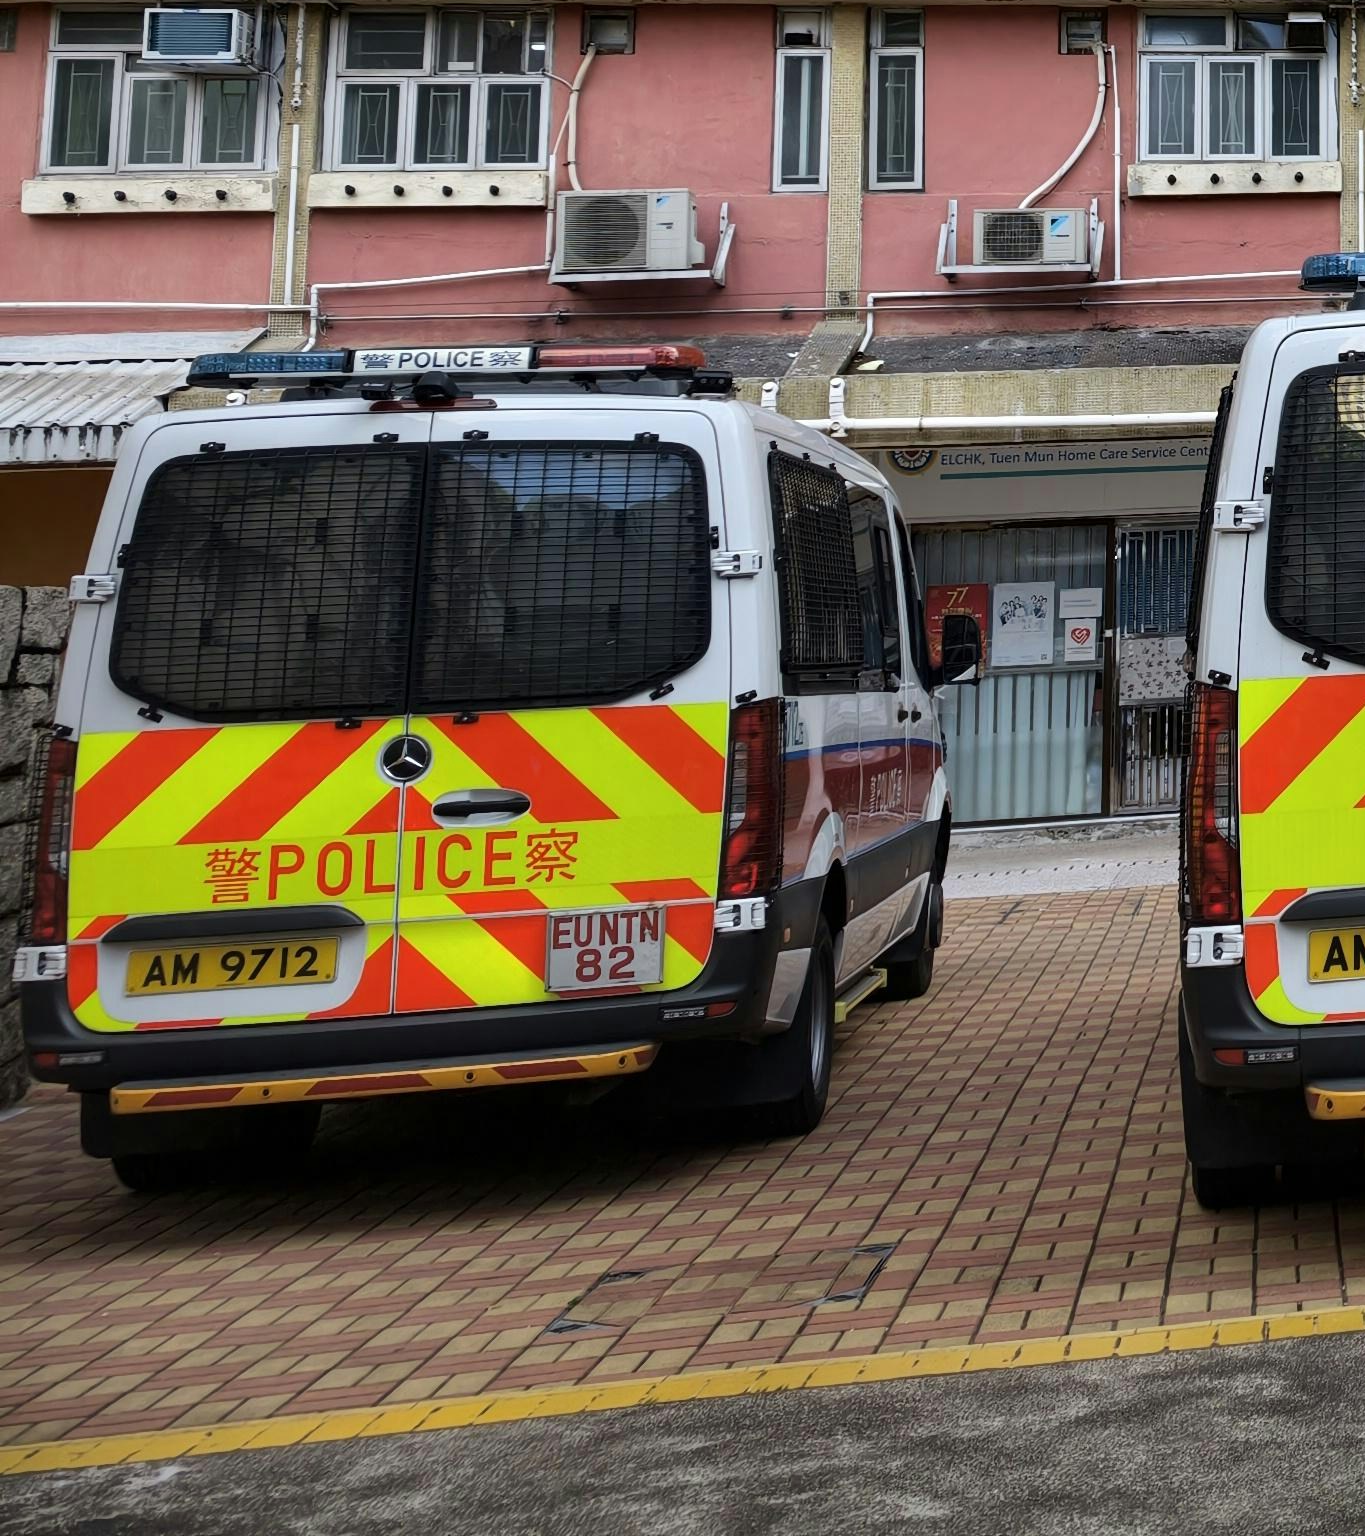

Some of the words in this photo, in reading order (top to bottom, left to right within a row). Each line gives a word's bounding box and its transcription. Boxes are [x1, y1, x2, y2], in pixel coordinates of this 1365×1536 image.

[940, 453, 985, 466] ELCHK,
[989, 452, 1020, 464] Tuen
[1024, 451, 1054, 462] Mun
[1058, 450, 1096, 461] Home
[1100, 448, 1128, 460] Care
[1131, 446, 1177, 459] Service
[142, 954, 200, 988] AM
[220, 945, 319, 983] 9712
[575, 945, 635, 983] 82
